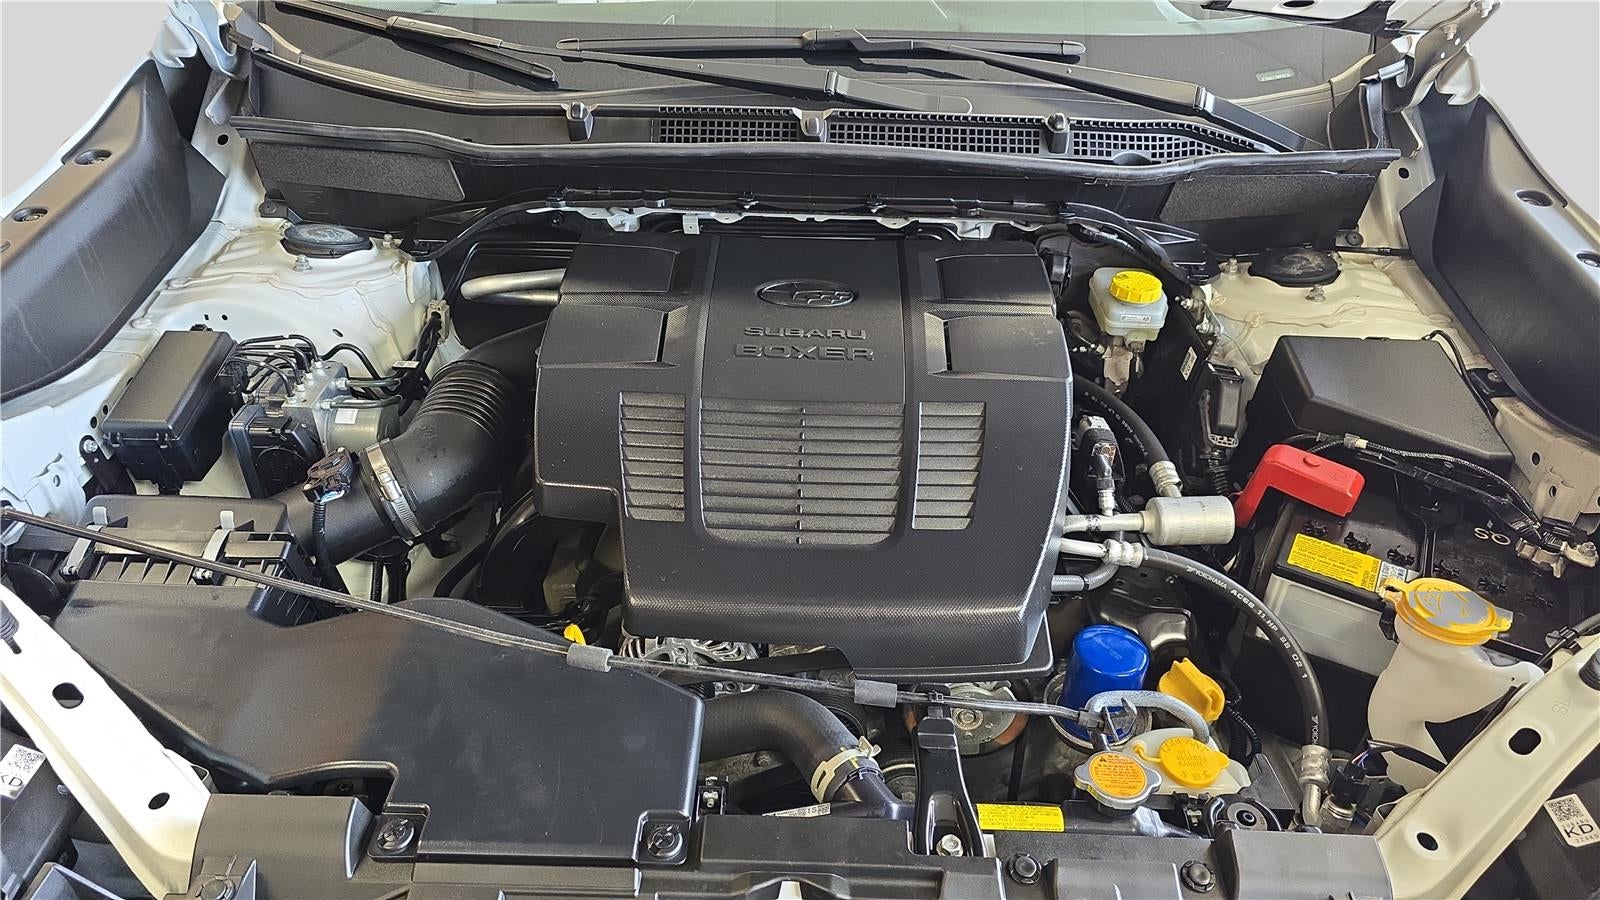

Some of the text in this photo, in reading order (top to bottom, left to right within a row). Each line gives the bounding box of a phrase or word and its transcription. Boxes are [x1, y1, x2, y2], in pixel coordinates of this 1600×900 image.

[744, 326, 867, 340] SUBARU
[734, 343, 875, 361] BOXER
[1193, 570, 1228, 590] YOKOHAMA
[1266, 619, 1279, 632] HP
[1564, 823, 1594, 838] KD
